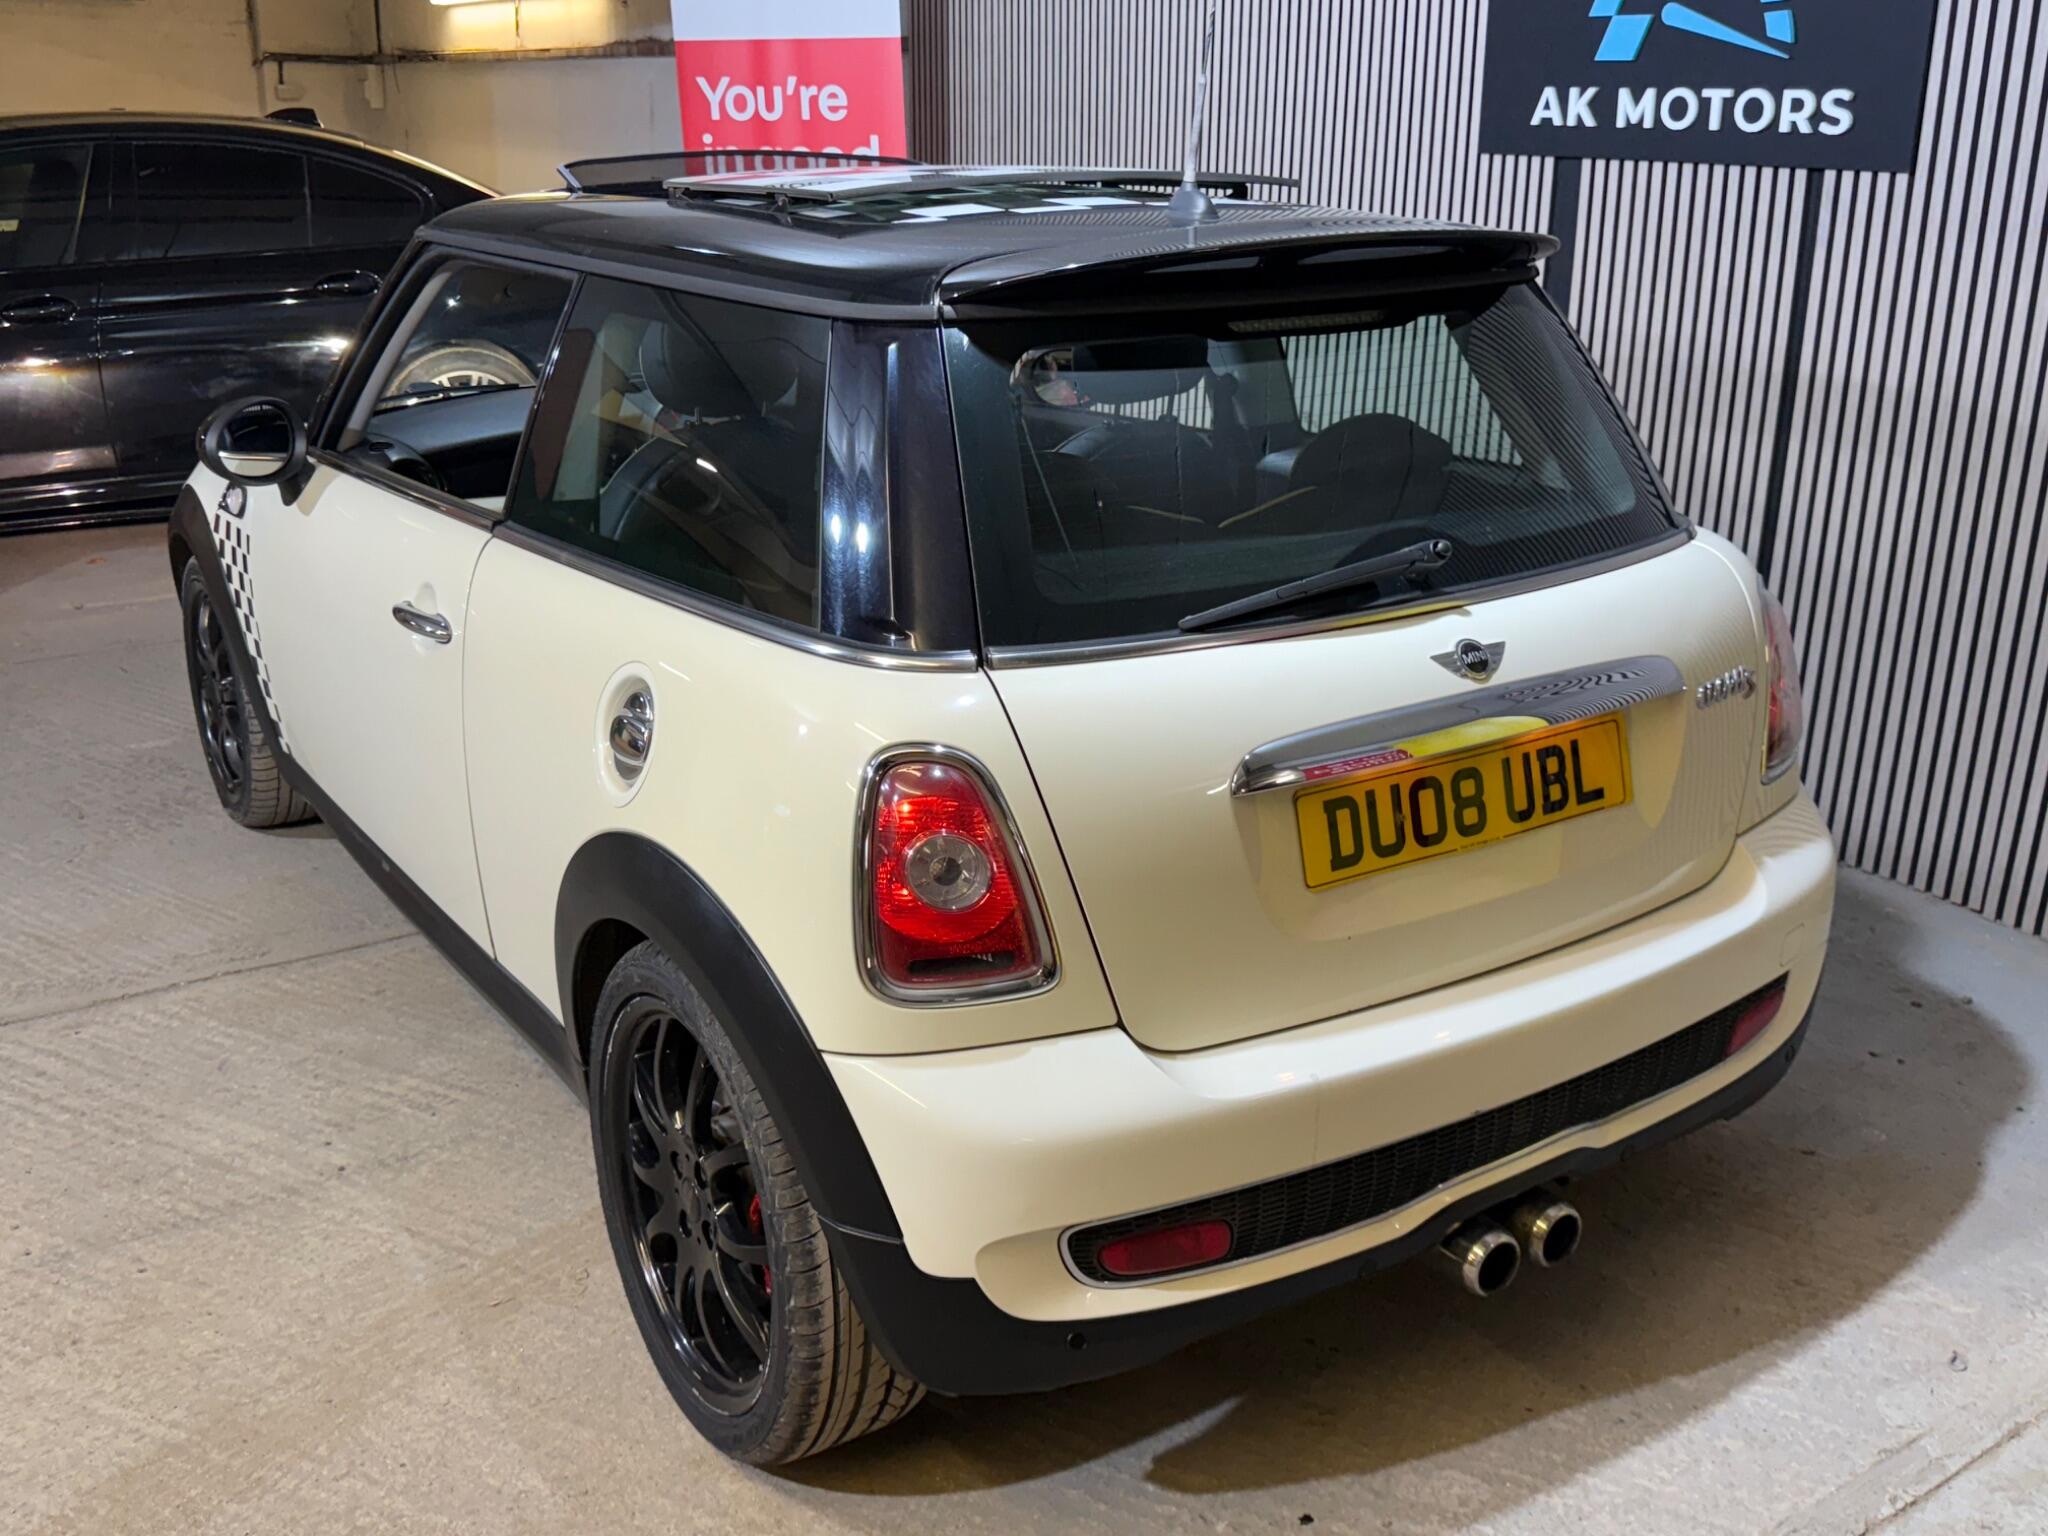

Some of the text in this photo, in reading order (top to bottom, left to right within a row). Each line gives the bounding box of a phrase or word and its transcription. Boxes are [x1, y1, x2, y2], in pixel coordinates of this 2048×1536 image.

[695, 76, 848, 121] You're
[1530, 86, 1855, 136] AK MOTORS
[702, 133, 745, 175] in
[1461, 649, 1489, 665] MINI
[1322, 739, 1605, 872] DU08 UBL
